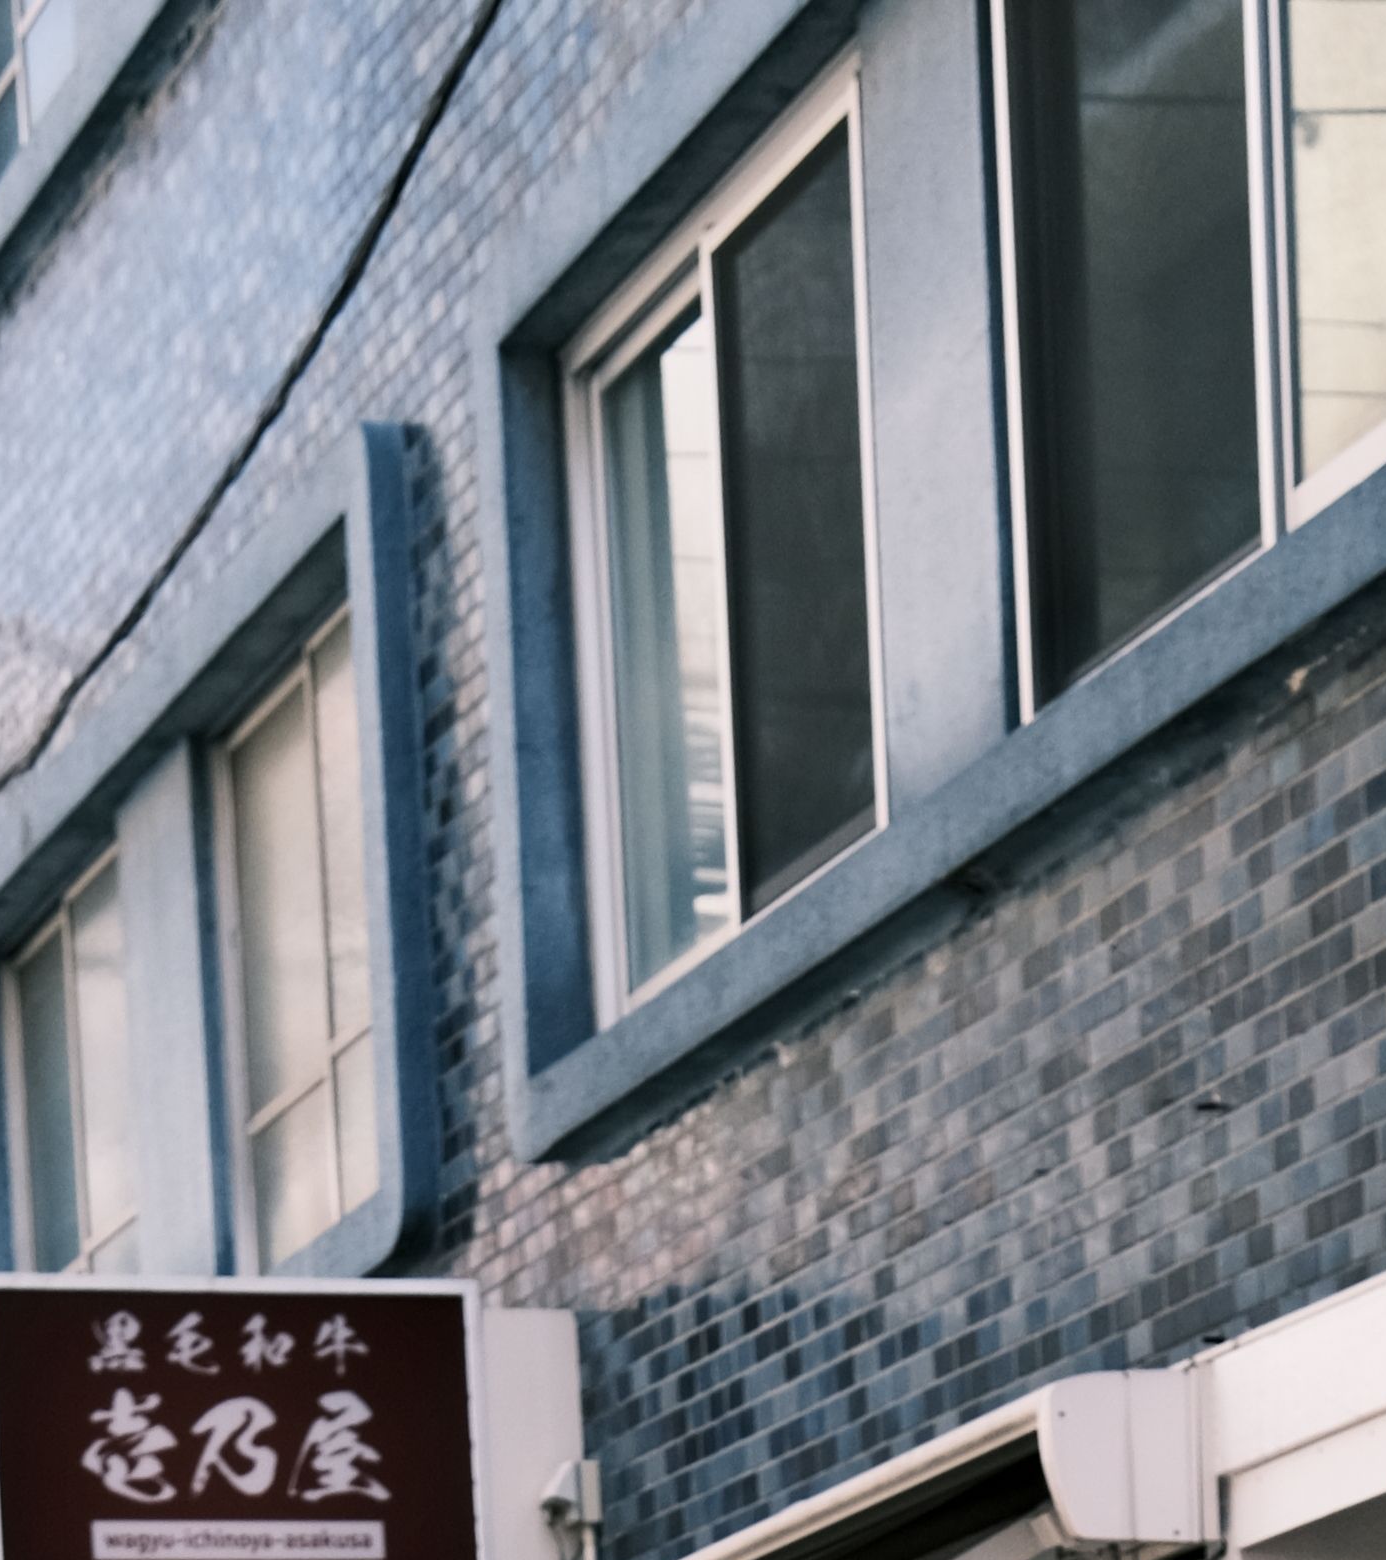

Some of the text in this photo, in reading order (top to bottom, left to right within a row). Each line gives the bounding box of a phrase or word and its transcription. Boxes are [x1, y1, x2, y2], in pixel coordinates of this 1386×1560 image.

[88, 1310, 370, 1375] 黒毛和牛
[103, 1527, 374, 1553] wagyu-ichinoya-asakusa
